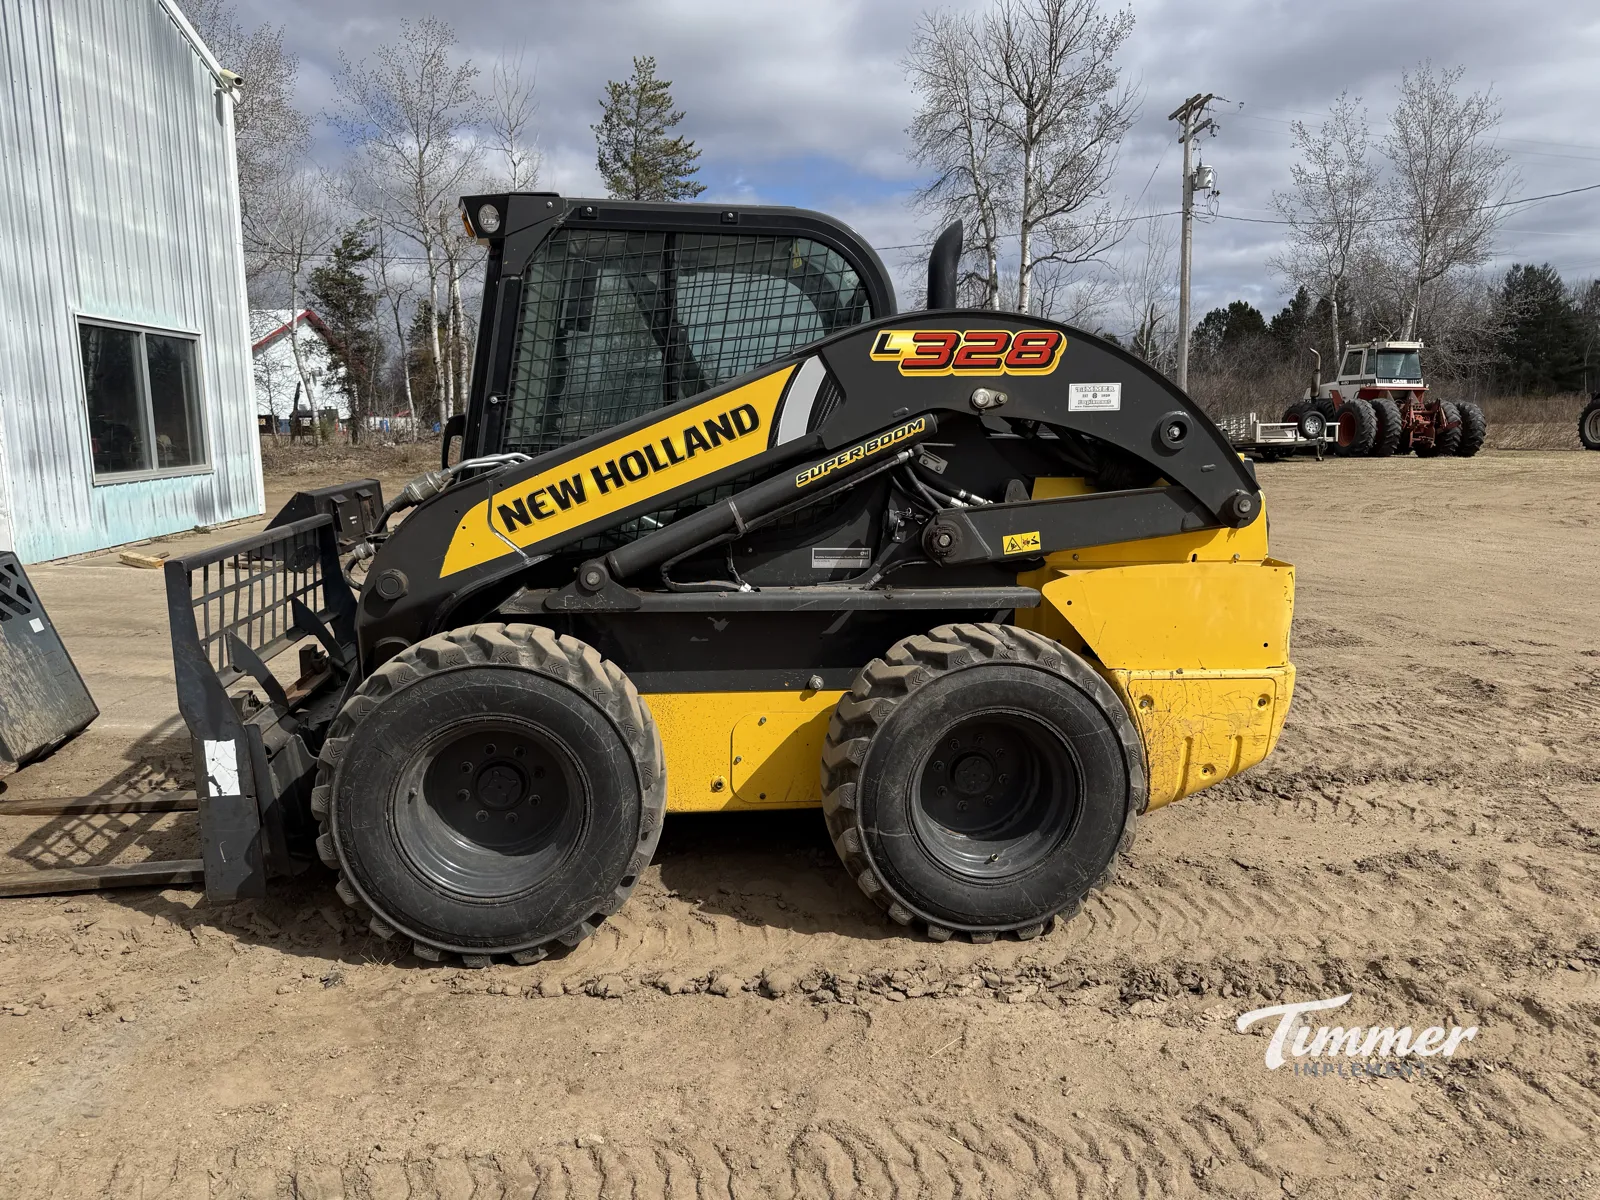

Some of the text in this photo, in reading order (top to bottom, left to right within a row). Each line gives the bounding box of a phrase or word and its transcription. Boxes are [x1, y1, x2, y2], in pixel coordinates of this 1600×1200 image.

[871, 331, 1065, 373] L328
[496, 403, 760, 533] NEW HOLLAND
[796, 418, 925, 487] SUPER BOOM
